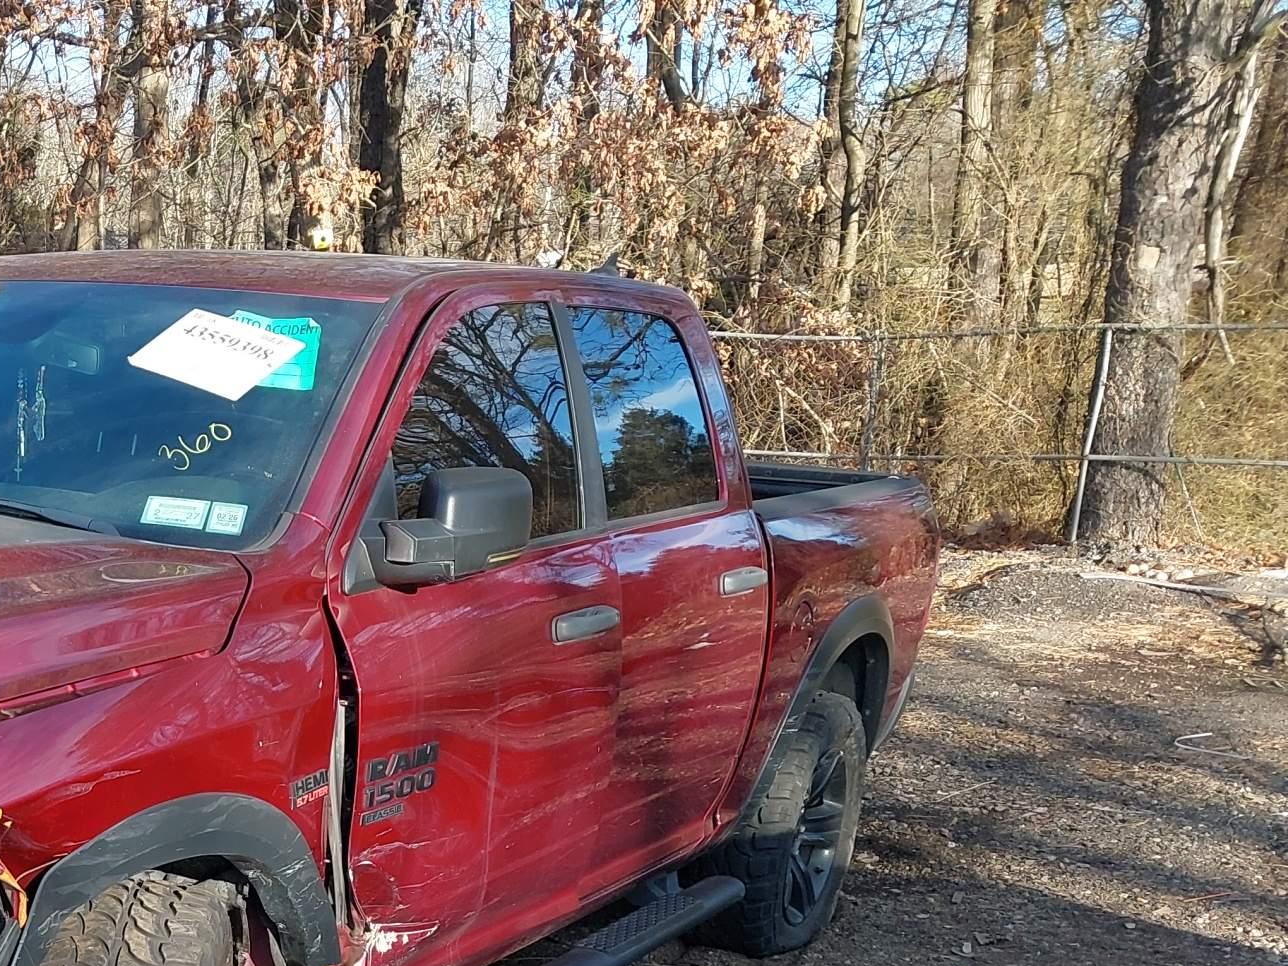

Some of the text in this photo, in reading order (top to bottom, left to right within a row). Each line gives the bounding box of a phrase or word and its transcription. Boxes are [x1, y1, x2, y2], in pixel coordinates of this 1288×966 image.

[230, 315, 261, 329] UTO
[158, 422, 232, 471] 360
[365, 741, 440, 782] RAM
[295, 770, 329, 796] HEMI
[364, 768, 437, 808] 1500
